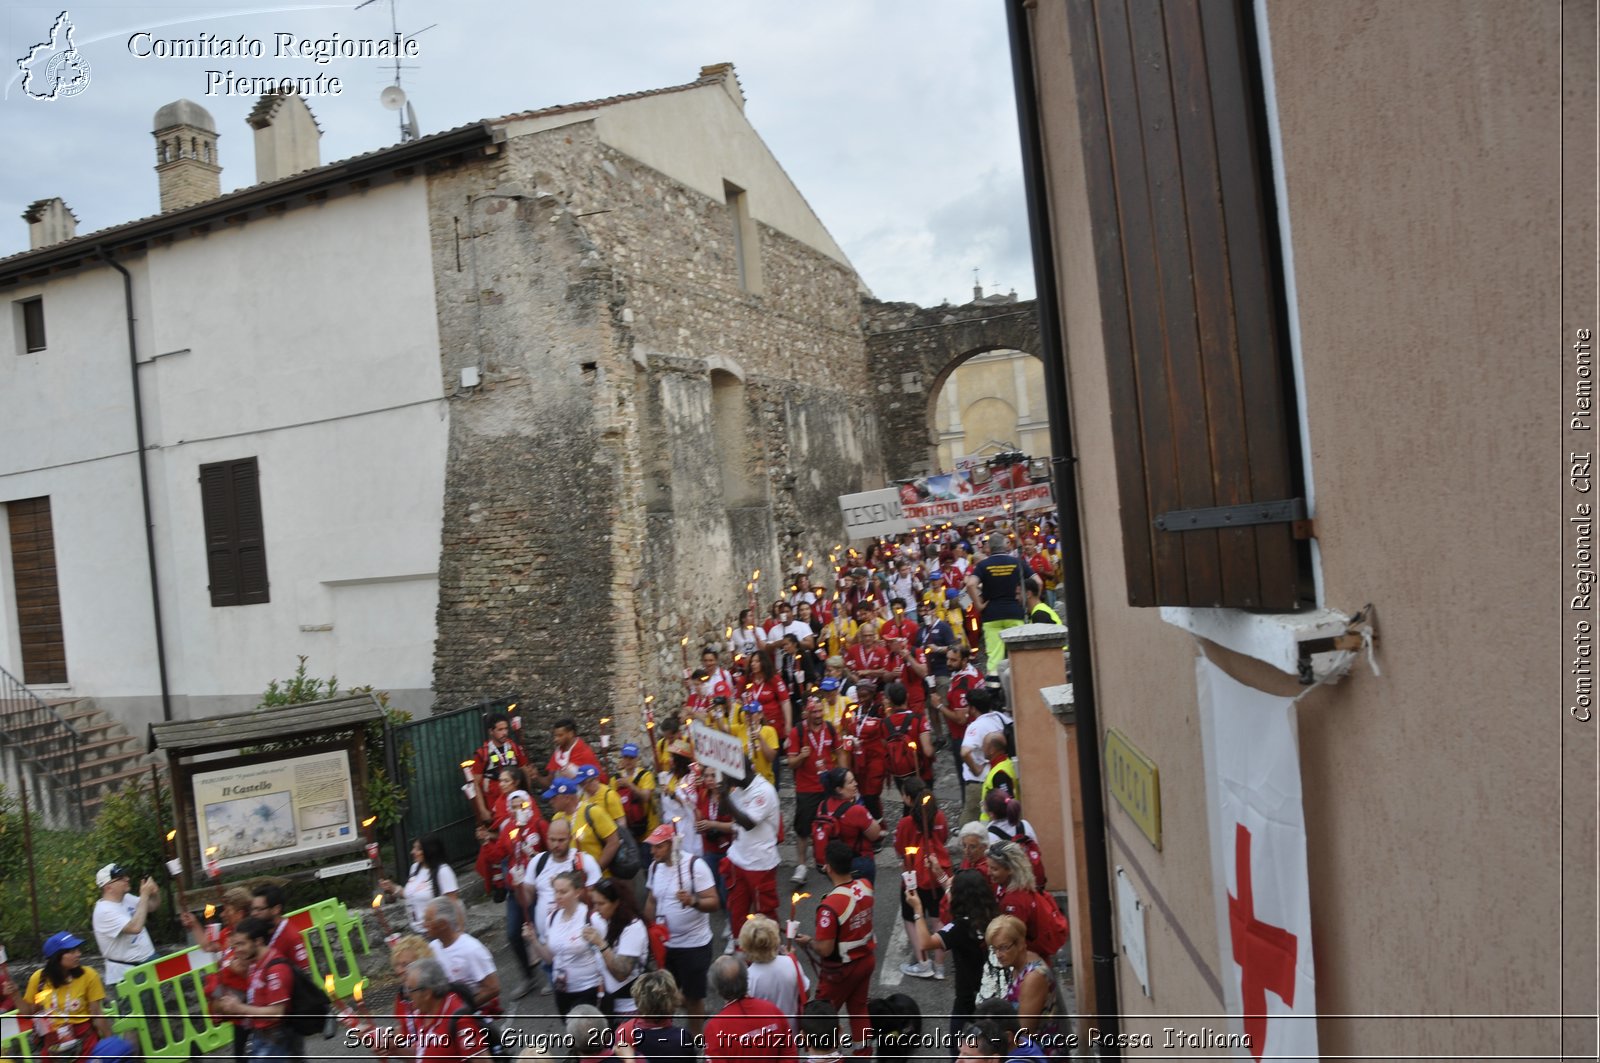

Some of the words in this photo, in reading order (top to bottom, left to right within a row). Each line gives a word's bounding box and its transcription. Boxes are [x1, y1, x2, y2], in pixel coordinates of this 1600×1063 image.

[903, 502, 959, 520] COMITATO
[962, 495, 1002, 512] BASSA
[233, 781, 273, 795] Castello
